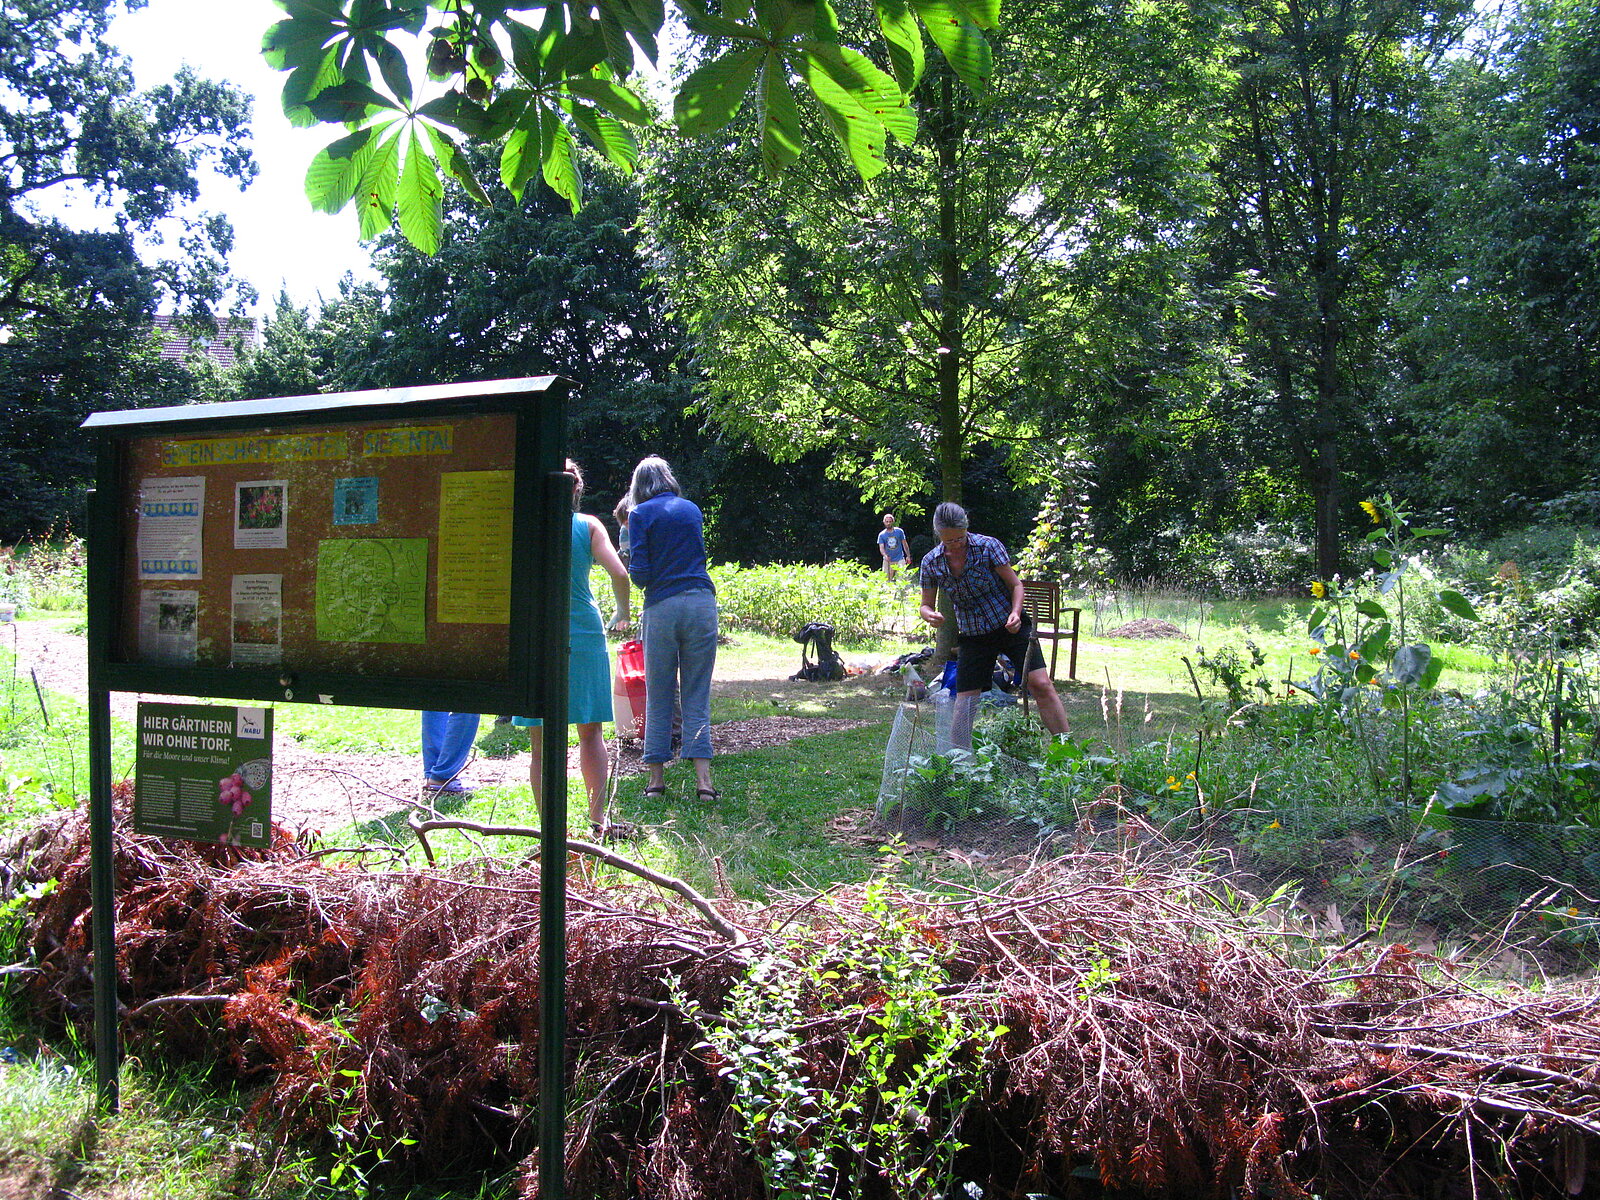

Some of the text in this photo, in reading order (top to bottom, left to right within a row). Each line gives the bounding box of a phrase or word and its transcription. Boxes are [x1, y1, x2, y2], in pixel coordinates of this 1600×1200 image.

[143, 715, 232, 734] HIER GÄRTNERN
[143, 732, 232, 752] WIR OHNE TORF.
[153, 751, 162, 759] die
[163, 752, 180, 761] Moore
[181, 753, 192, 761] und
[194, 755, 210, 763] unser
[210, 754, 230, 765] Klima!
